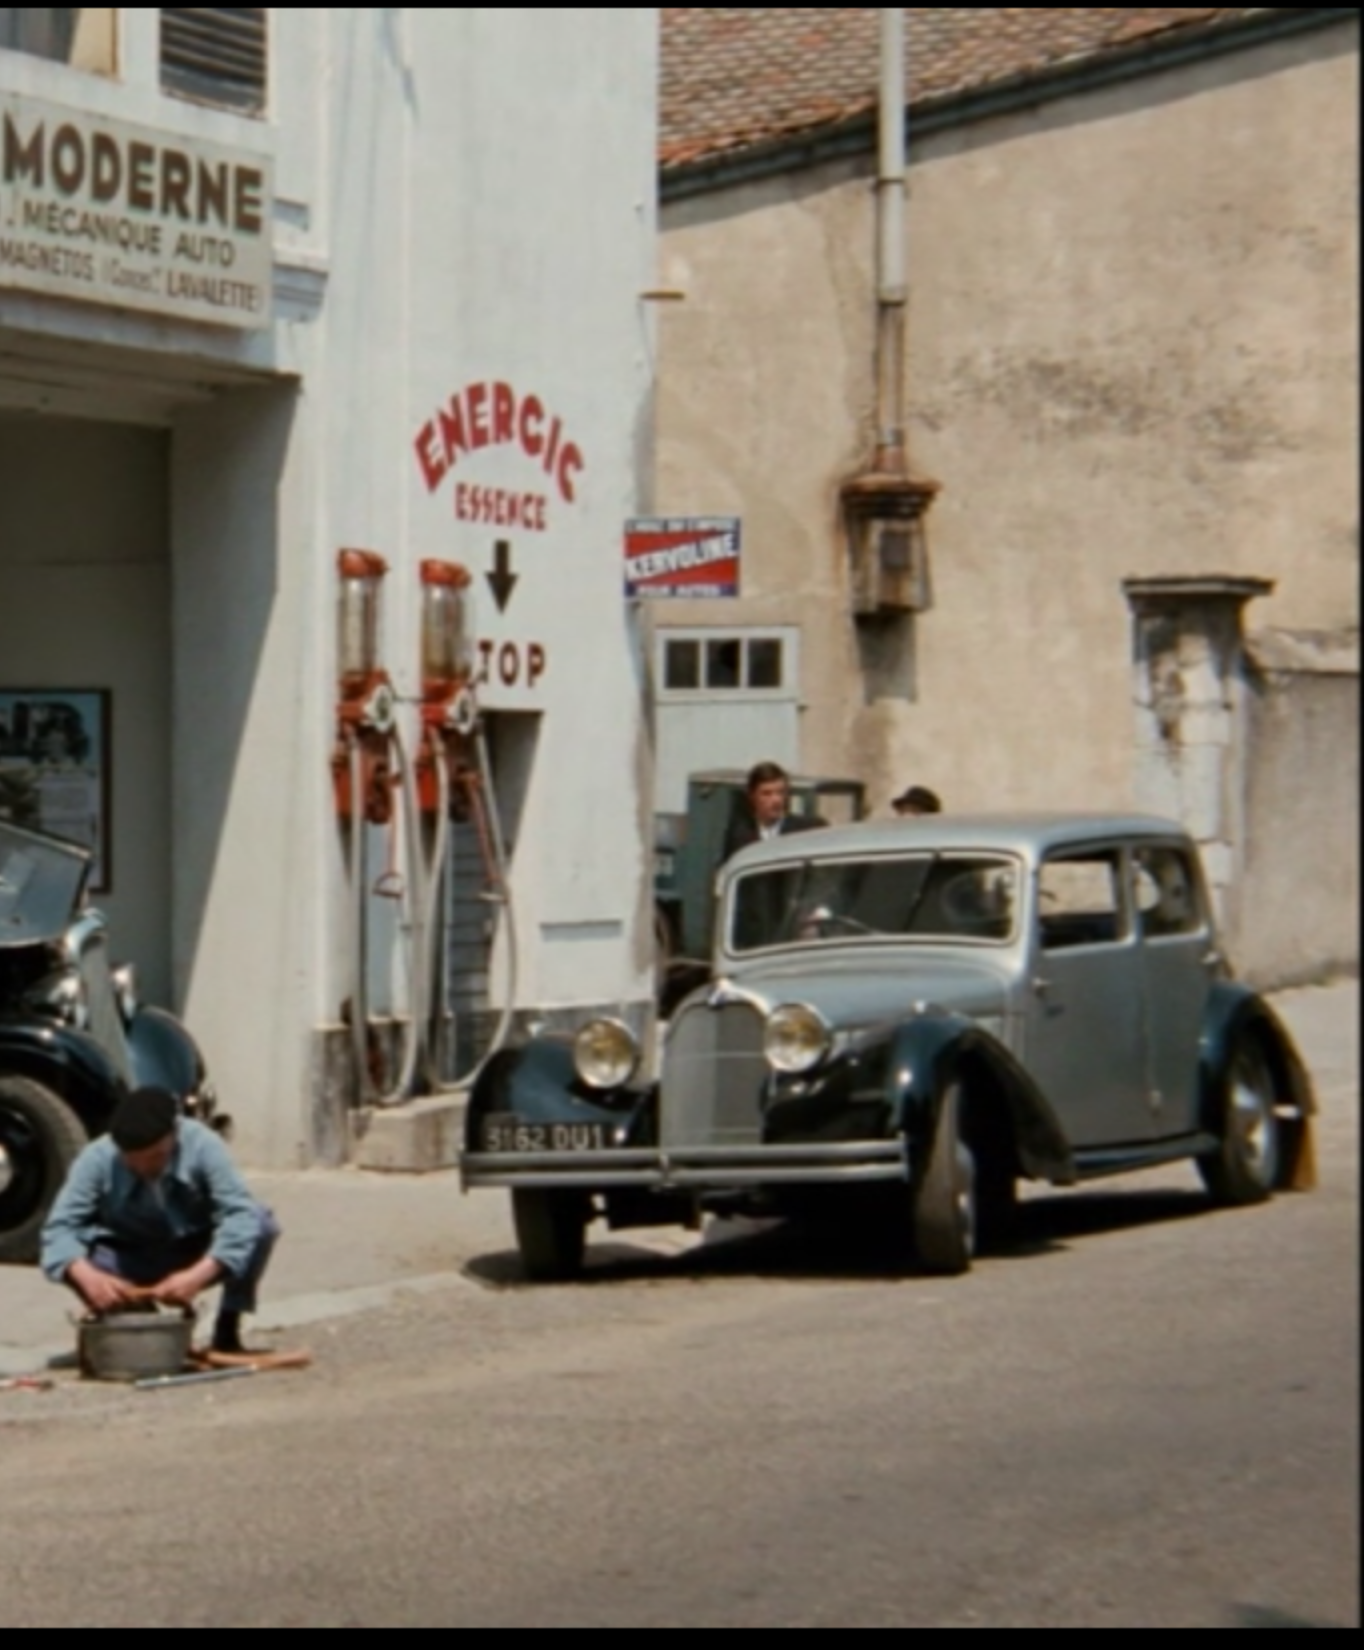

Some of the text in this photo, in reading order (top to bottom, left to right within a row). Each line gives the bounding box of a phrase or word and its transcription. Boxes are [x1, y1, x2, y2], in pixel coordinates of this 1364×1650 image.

[4, 110, 263, 234] MODERNE
[174, 231, 235, 268] AUTO
[413, 380, 585, 505] ENERGIC
[456, 482, 548, 532] ESSENCE
[478, 640, 547, 688] TOP
